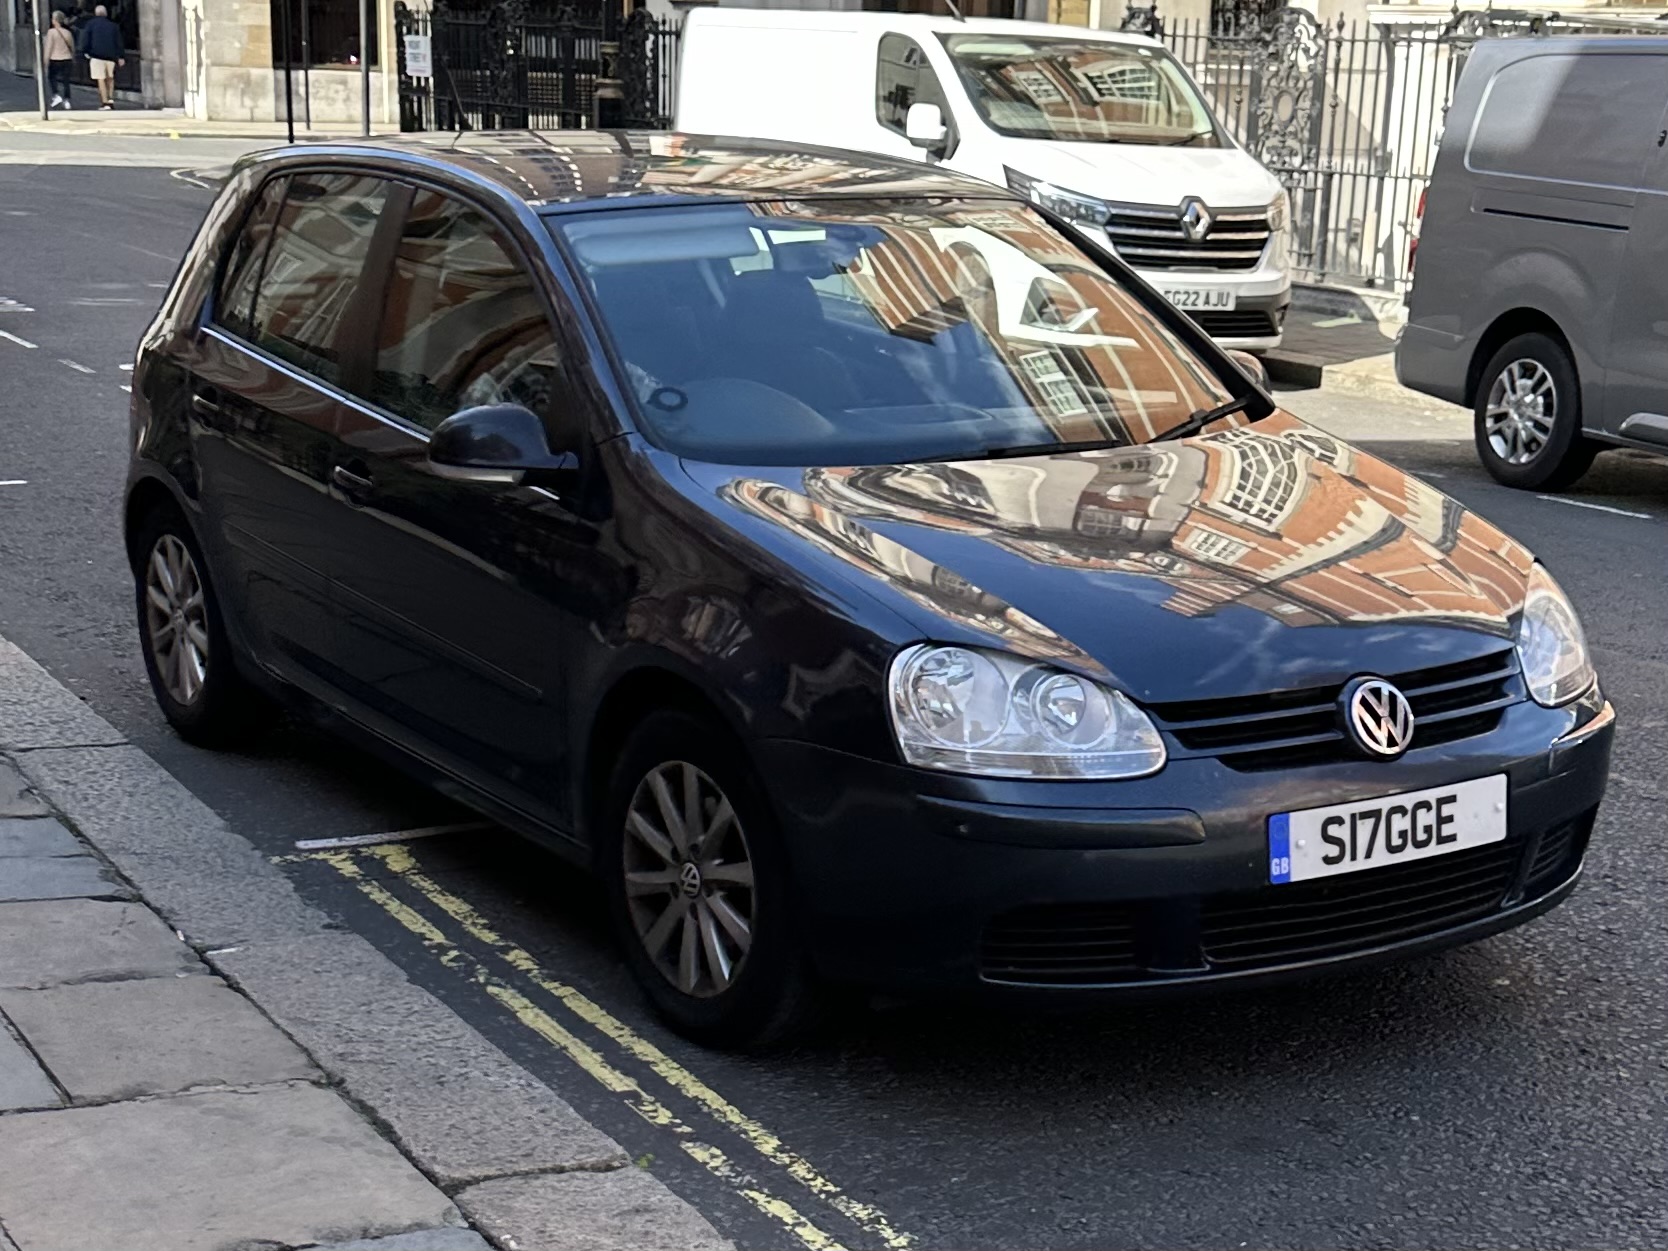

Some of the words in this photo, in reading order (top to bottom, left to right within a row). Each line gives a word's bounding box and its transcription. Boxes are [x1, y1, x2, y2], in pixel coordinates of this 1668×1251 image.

[1203, 291, 1231, 307] AJU
[1321, 794, 1458, 866] S17GGE
[1271, 856, 1289, 876] GB
